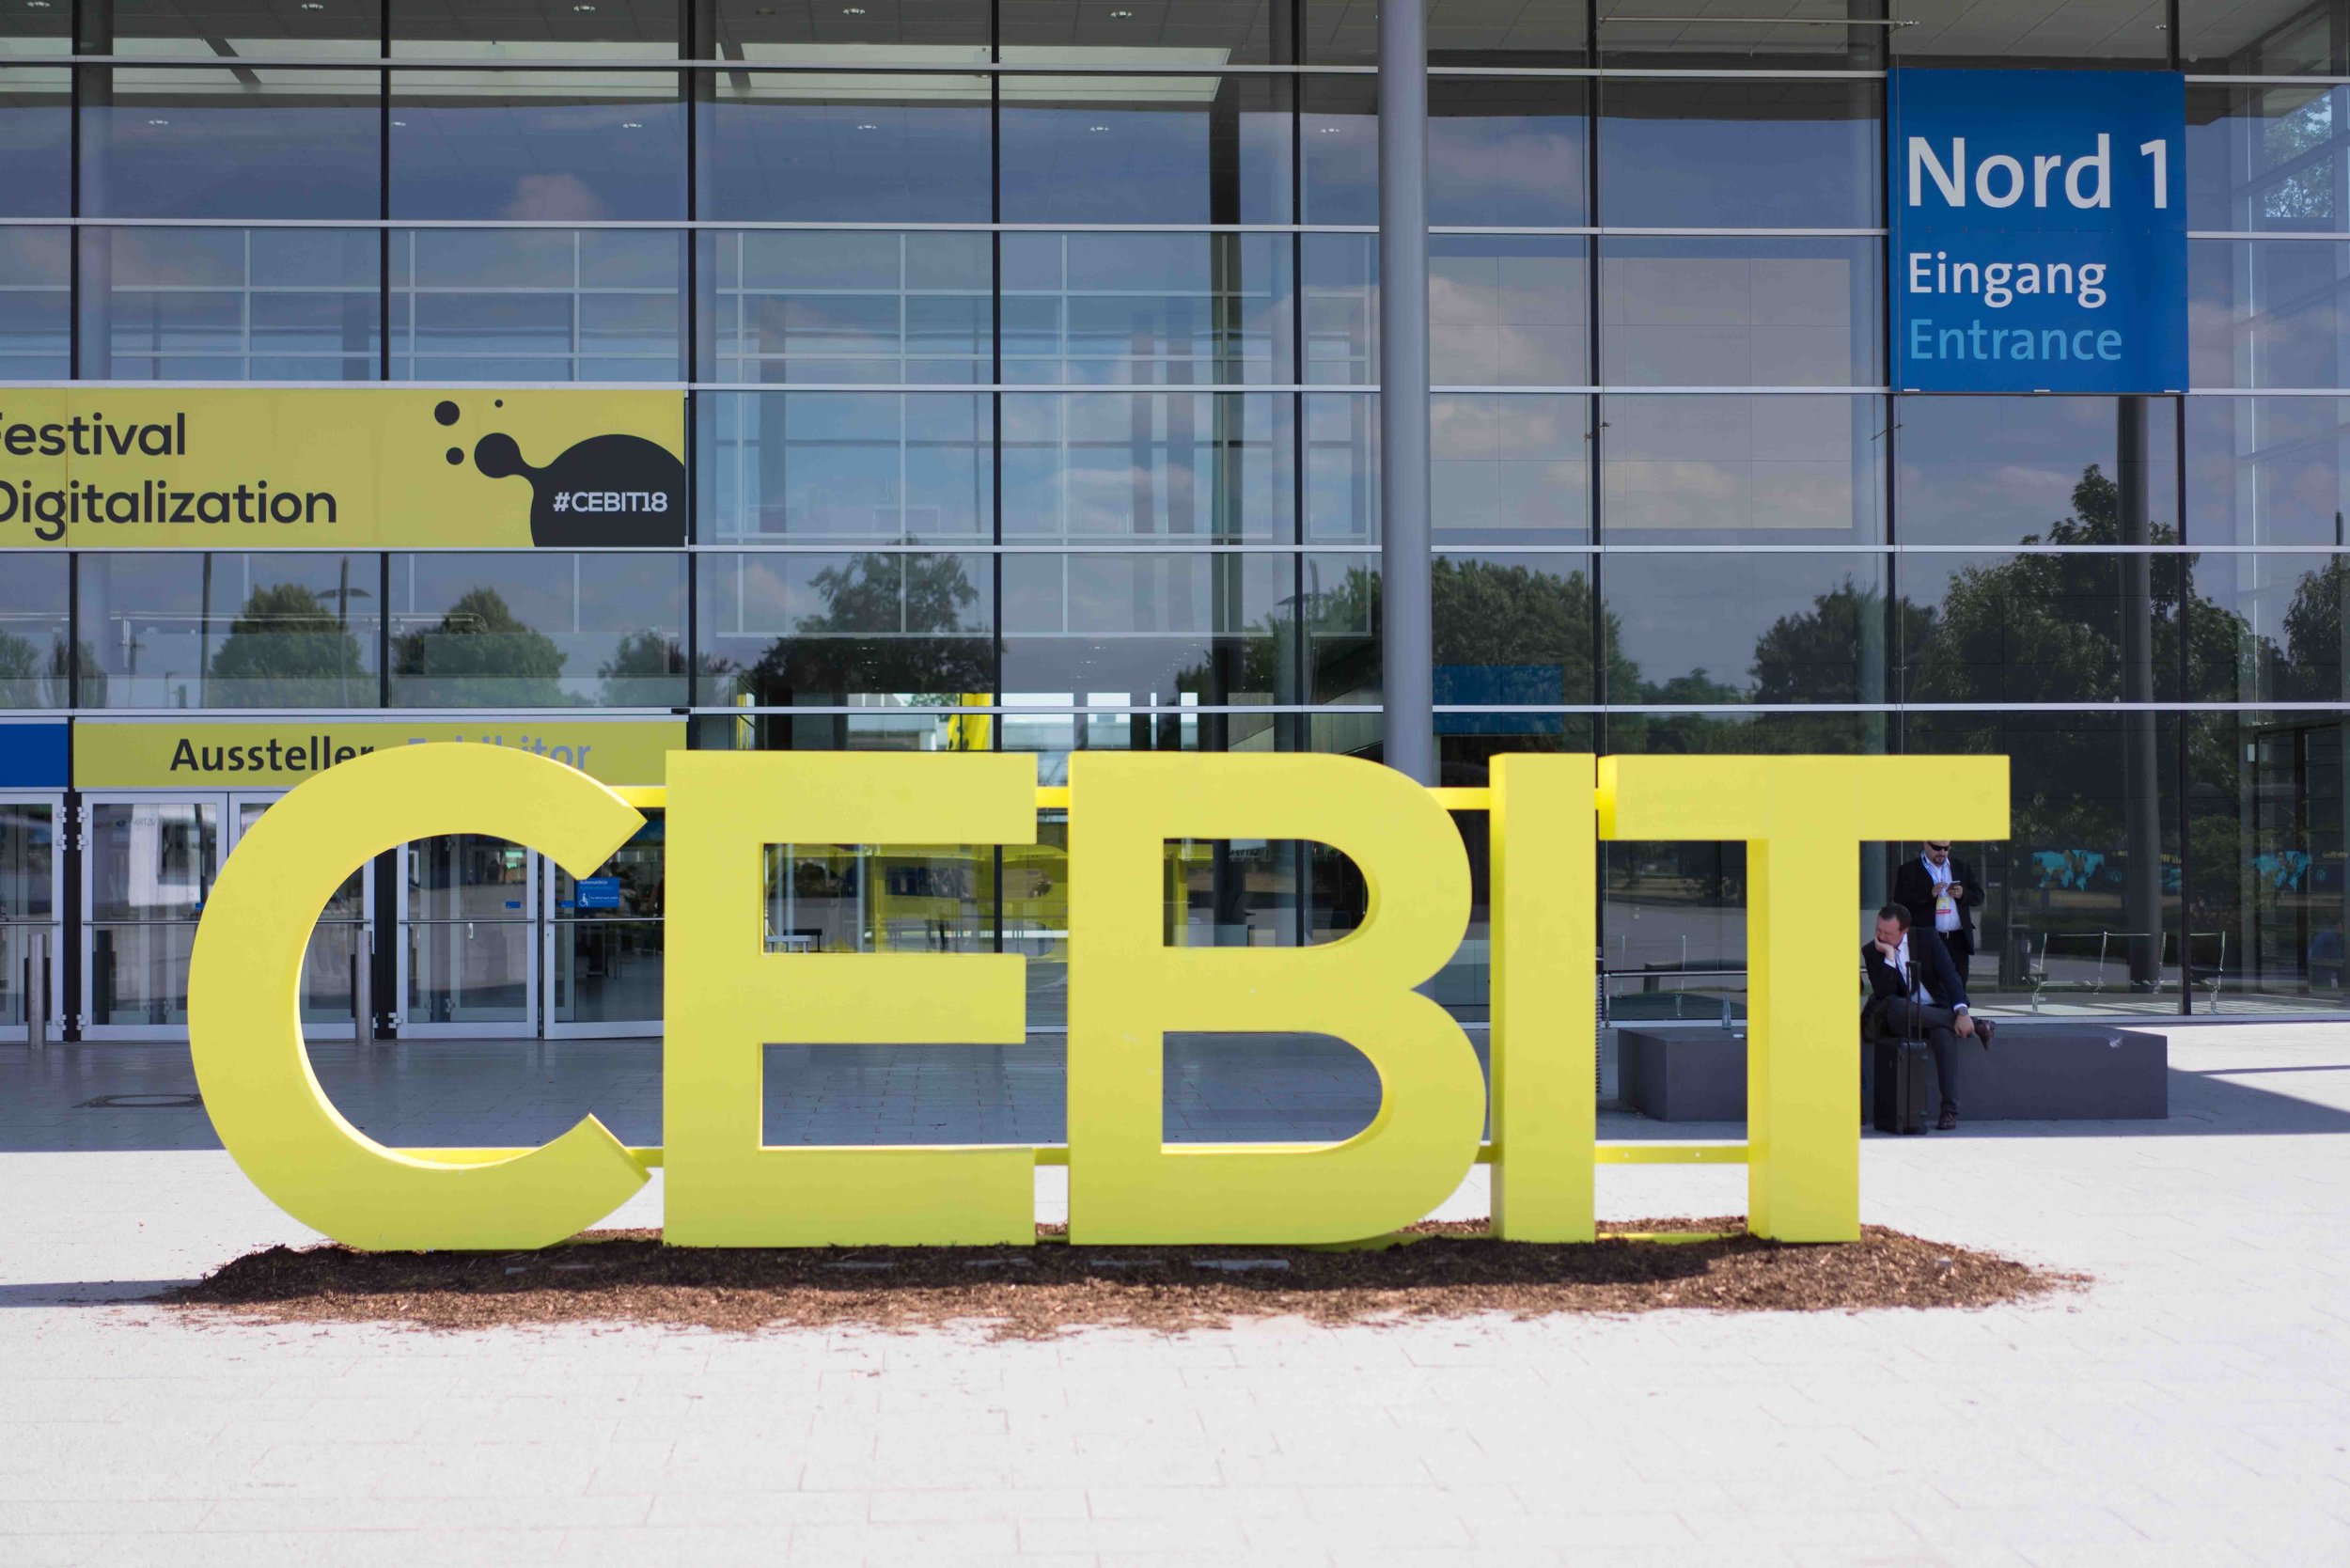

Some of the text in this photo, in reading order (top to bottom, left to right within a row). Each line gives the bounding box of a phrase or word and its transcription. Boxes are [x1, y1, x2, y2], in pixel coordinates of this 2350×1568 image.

[1908, 133, 2168, 209] Nord 1
[1909, 251, 2107, 308] Eingang
[1910, 319, 2123, 361] Entrance
[0, 412, 186, 456] estival
[553, 491, 668, 512] #CEBIT18
[188, 743, 2011, 1251] CEBIT
